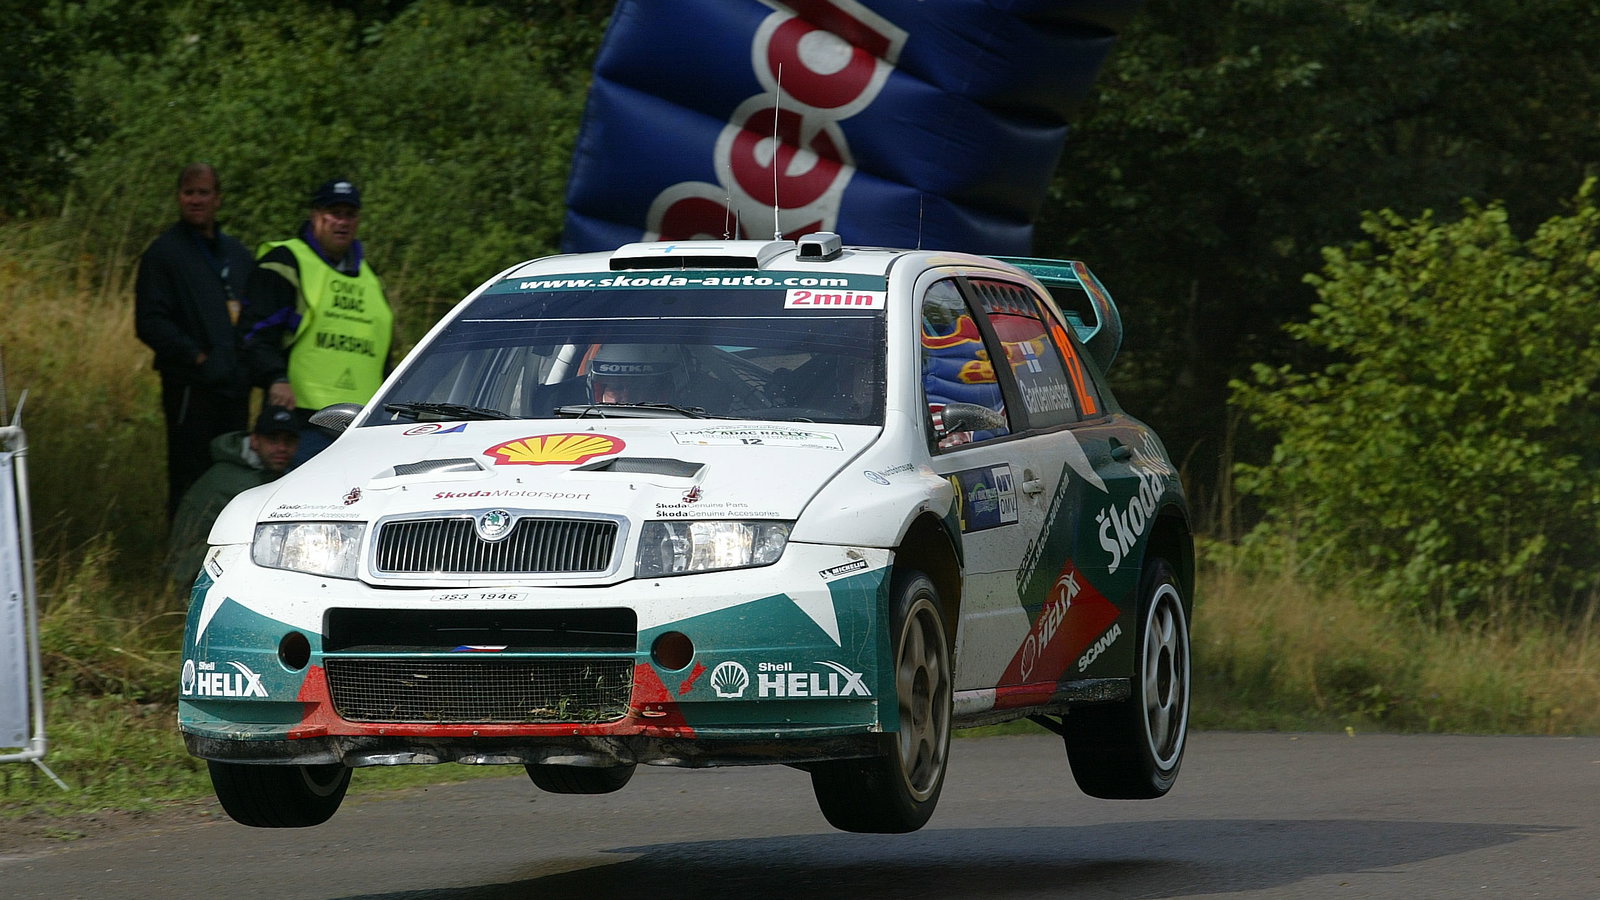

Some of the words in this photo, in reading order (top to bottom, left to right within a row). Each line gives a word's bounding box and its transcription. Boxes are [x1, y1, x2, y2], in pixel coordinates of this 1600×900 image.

[519, 273, 849, 290] www.skoda-auto.com
[331, 294, 365, 313] ADAC
[792, 290, 873, 306] 2min
[314, 332, 377, 357] MARSHAL
[600, 364, 654, 372] SOTKA
[740, 438, 765, 446] 12
[831, 560, 867, 576] MICHELIN
[1037, 571, 1081, 658] HELIX
[1078, 623, 1122, 674] SCANIA
[198, 661, 216, 671] Shell
[758, 662, 793, 672] Shell
[197, 661, 269, 697] HELIX
[757, 660, 872, 697] HELIX
